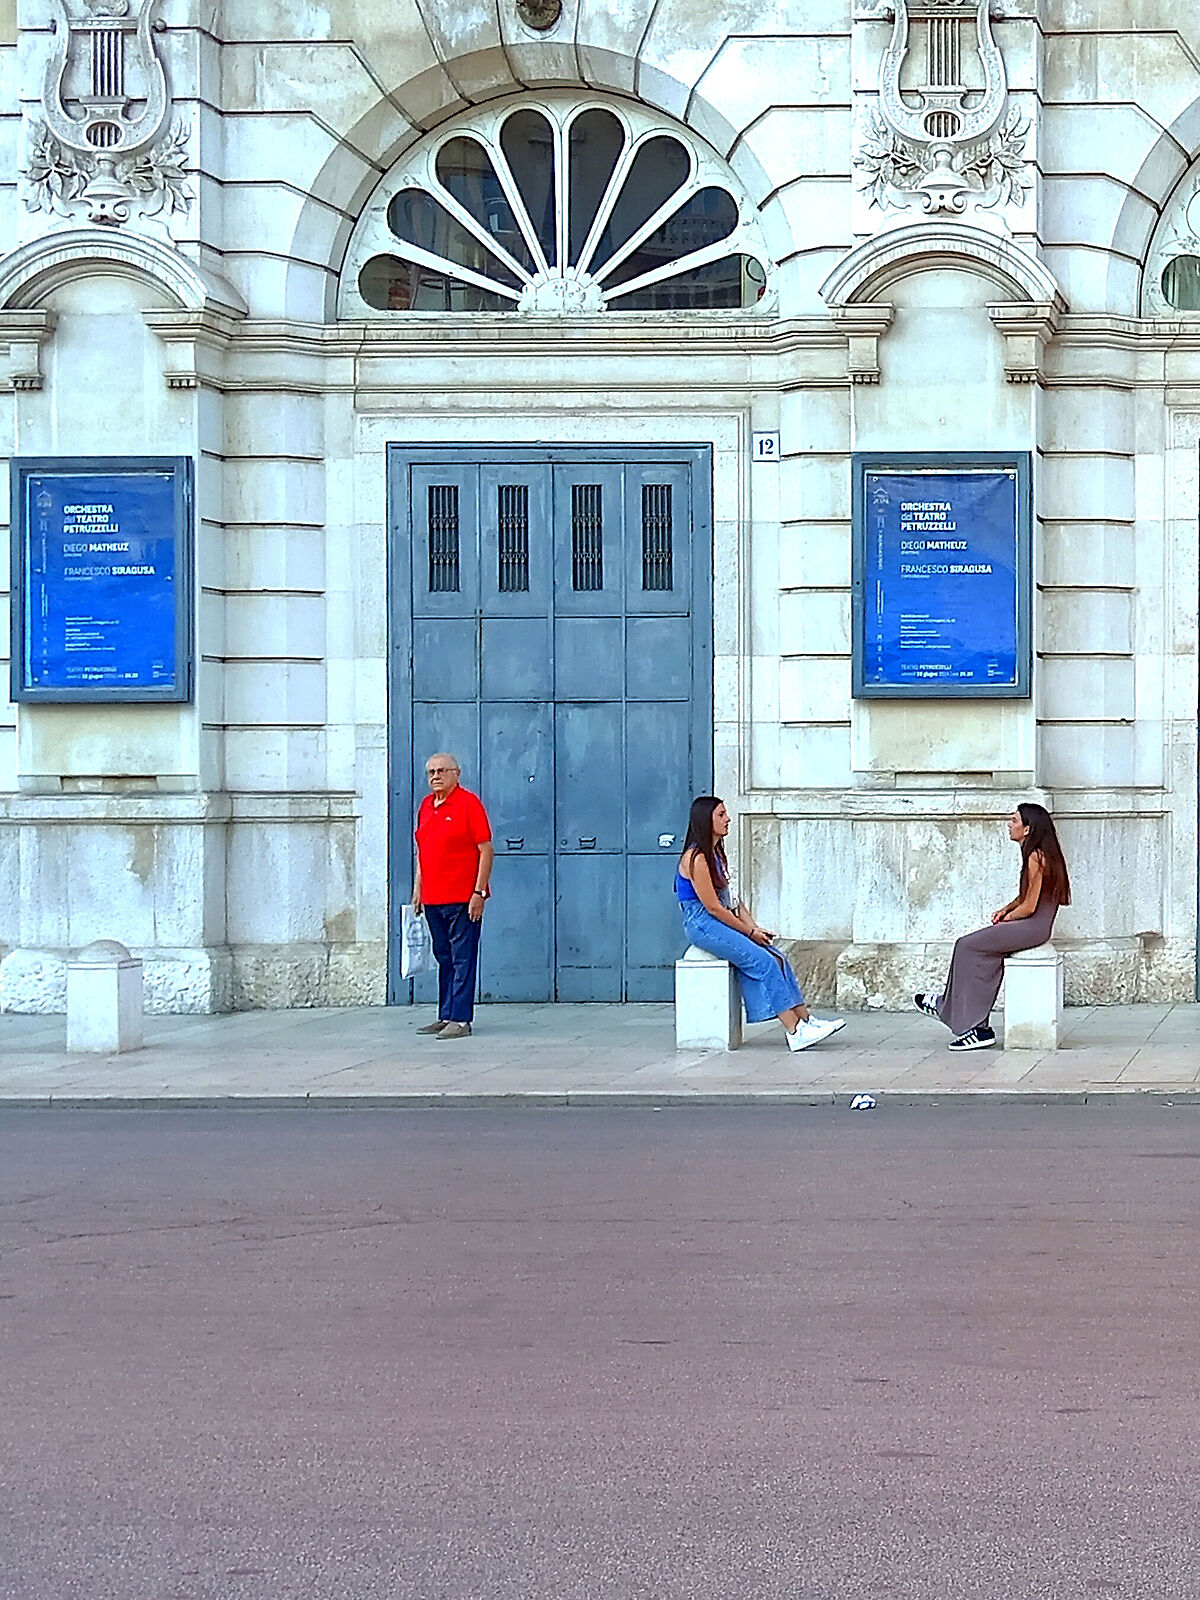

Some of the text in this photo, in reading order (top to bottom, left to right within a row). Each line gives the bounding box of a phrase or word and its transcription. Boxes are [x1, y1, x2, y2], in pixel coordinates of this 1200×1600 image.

[759, 438, 774, 455] 12
[63, 504, 114, 514] ORCHESTRA
[900, 502, 952, 512] ORCHESTRA
[76, 514, 109, 524] TEATRO
[913, 511, 947, 521] TEATRO
[63, 524, 119, 534] PETRUZZELLI
[900, 521, 957, 531] PETRUZZELLI
[63, 542, 130, 553] DIEGO MATHEUZ
[901, 540, 968, 550] DIEGO MATHEUZ
[64, 566, 156, 576] FRANCESCO SIRAGUSA
[900, 564, 993, 574] FRANCESCO SIRAGUSA
